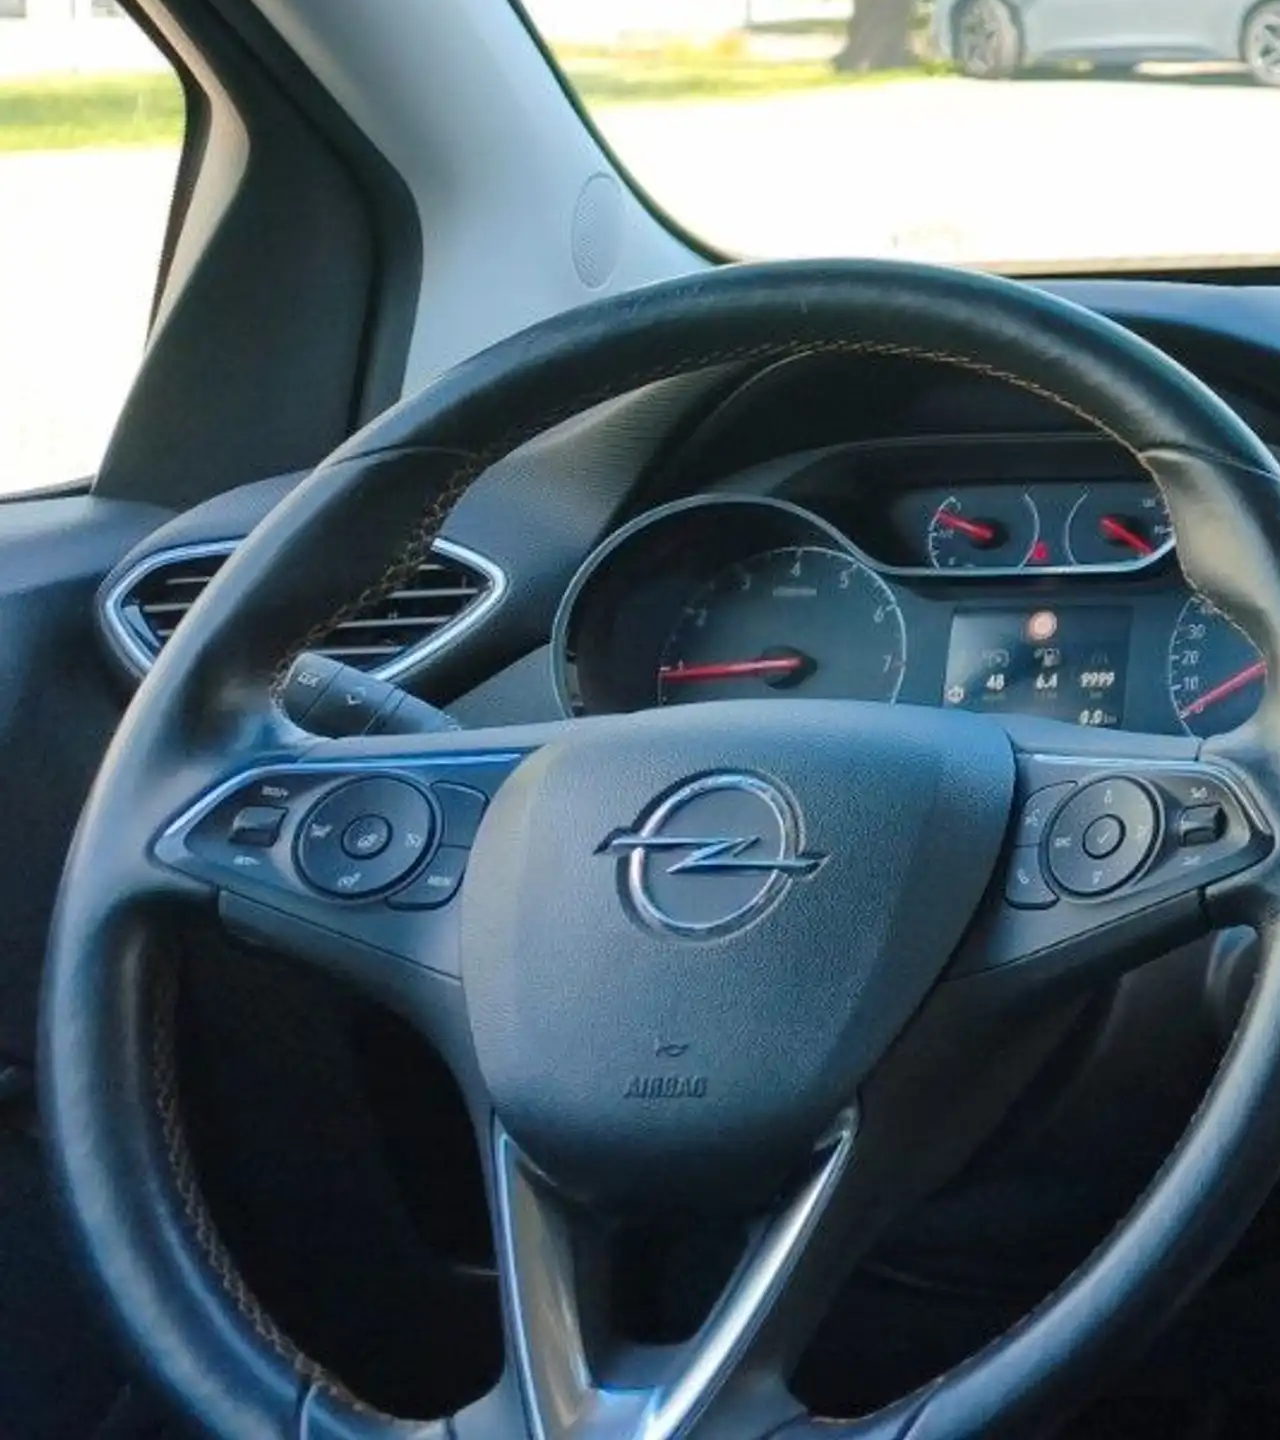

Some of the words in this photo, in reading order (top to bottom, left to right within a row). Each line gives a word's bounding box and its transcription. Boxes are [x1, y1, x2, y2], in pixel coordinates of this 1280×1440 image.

[839, 570, 849, 589] 5
[873, 605, 885, 623] 6
[1188, 623, 1206, 639] 30
[883, 655, 892, 673] 7
[1182, 651, 1199, 664] 20
[986, 673, 1005, 690] 48
[1035, 671, 1058, 689] 6.4
[1080, 671, 1115, 688] 9999
[1183, 677, 1199, 690] 10
[623, 1076, 708, 1098] AIRBAG
